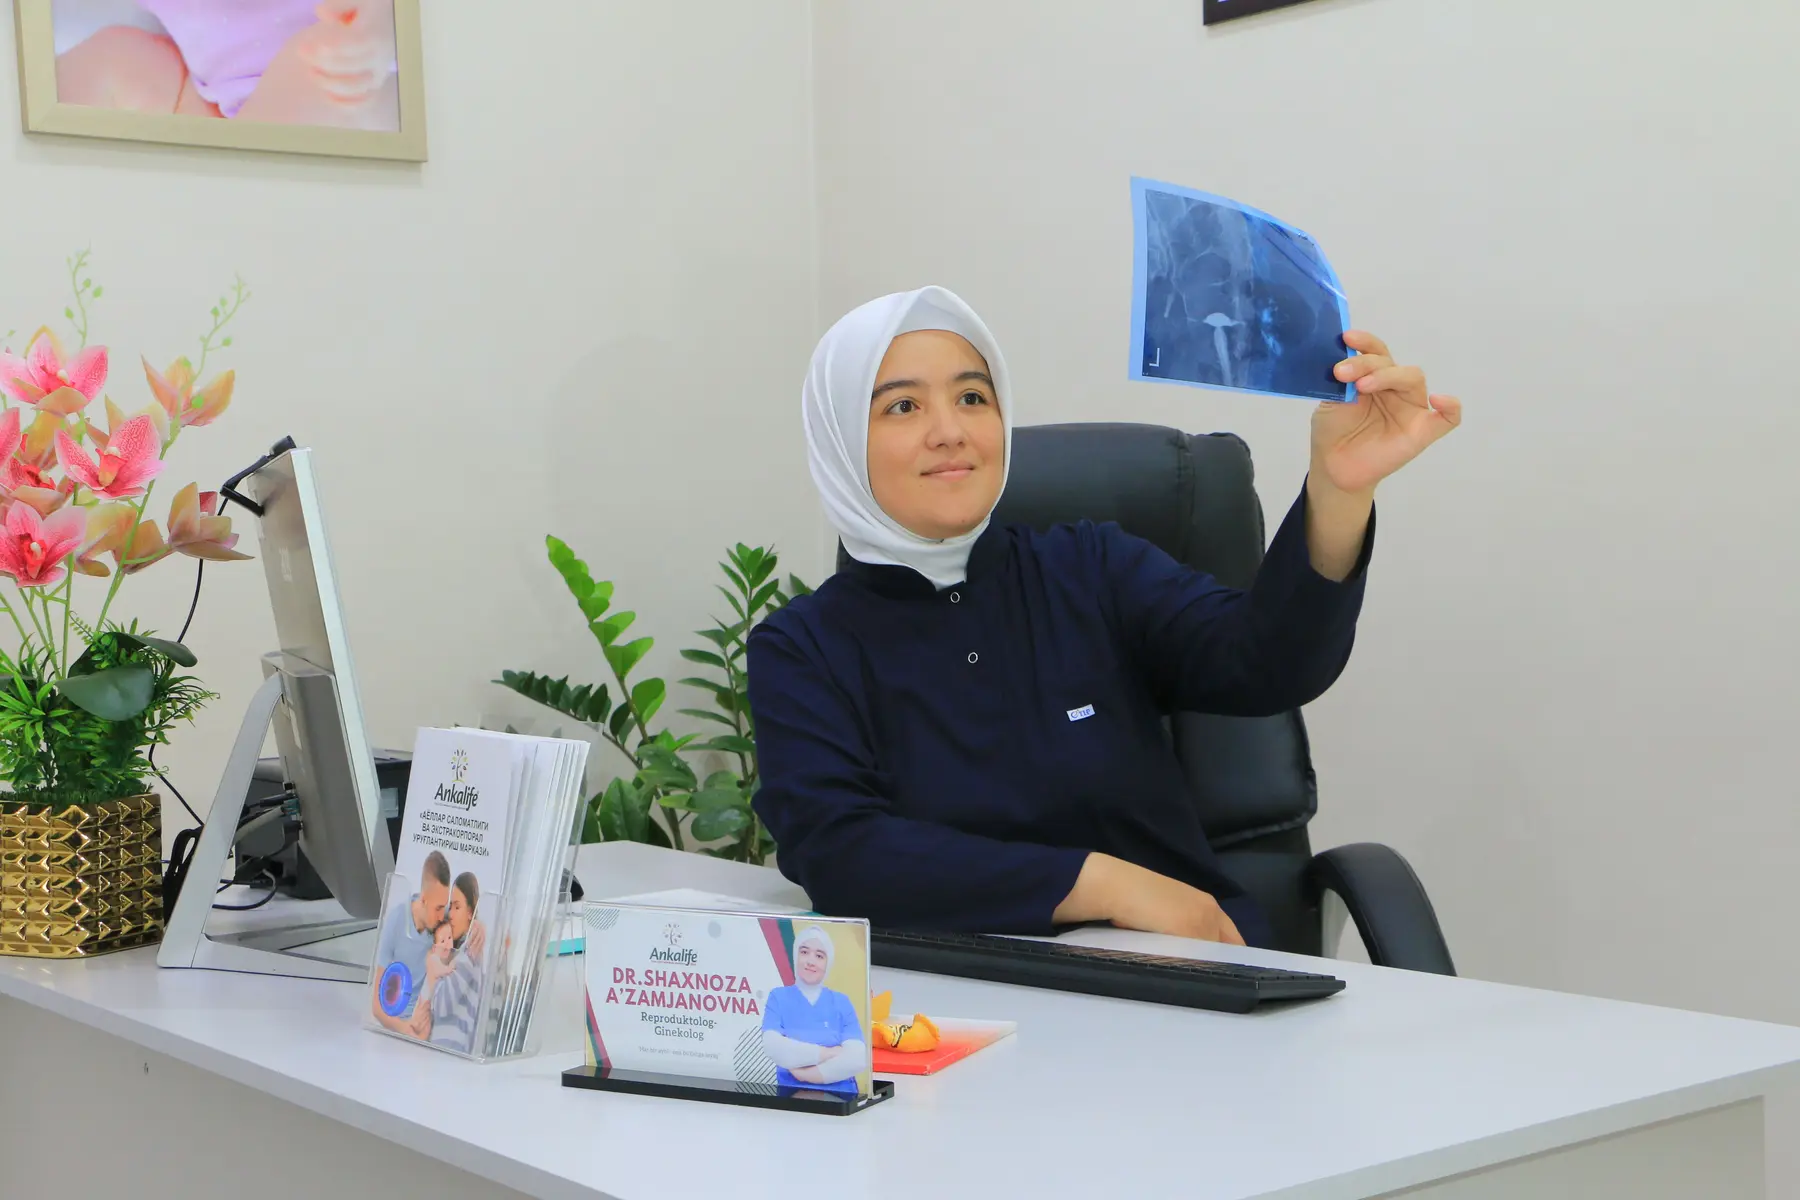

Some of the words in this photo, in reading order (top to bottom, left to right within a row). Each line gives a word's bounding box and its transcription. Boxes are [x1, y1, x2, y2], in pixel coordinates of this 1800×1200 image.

[434, 782, 478, 811] Ankalife
[446, 815, 489, 831] САЛОМАТЛИГИ
[422, 823, 430, 832] ВА
[431, 824, 483, 843] ЭКСТРАКОРПОРАЛ
[650, 947, 698, 966] Ankalife
[613, 967, 751, 994] DR.SHAXNOZA
[641, 1012, 717, 1029] Reproduktolog-
[654, 1026, 704, 1041] Ginekolog
